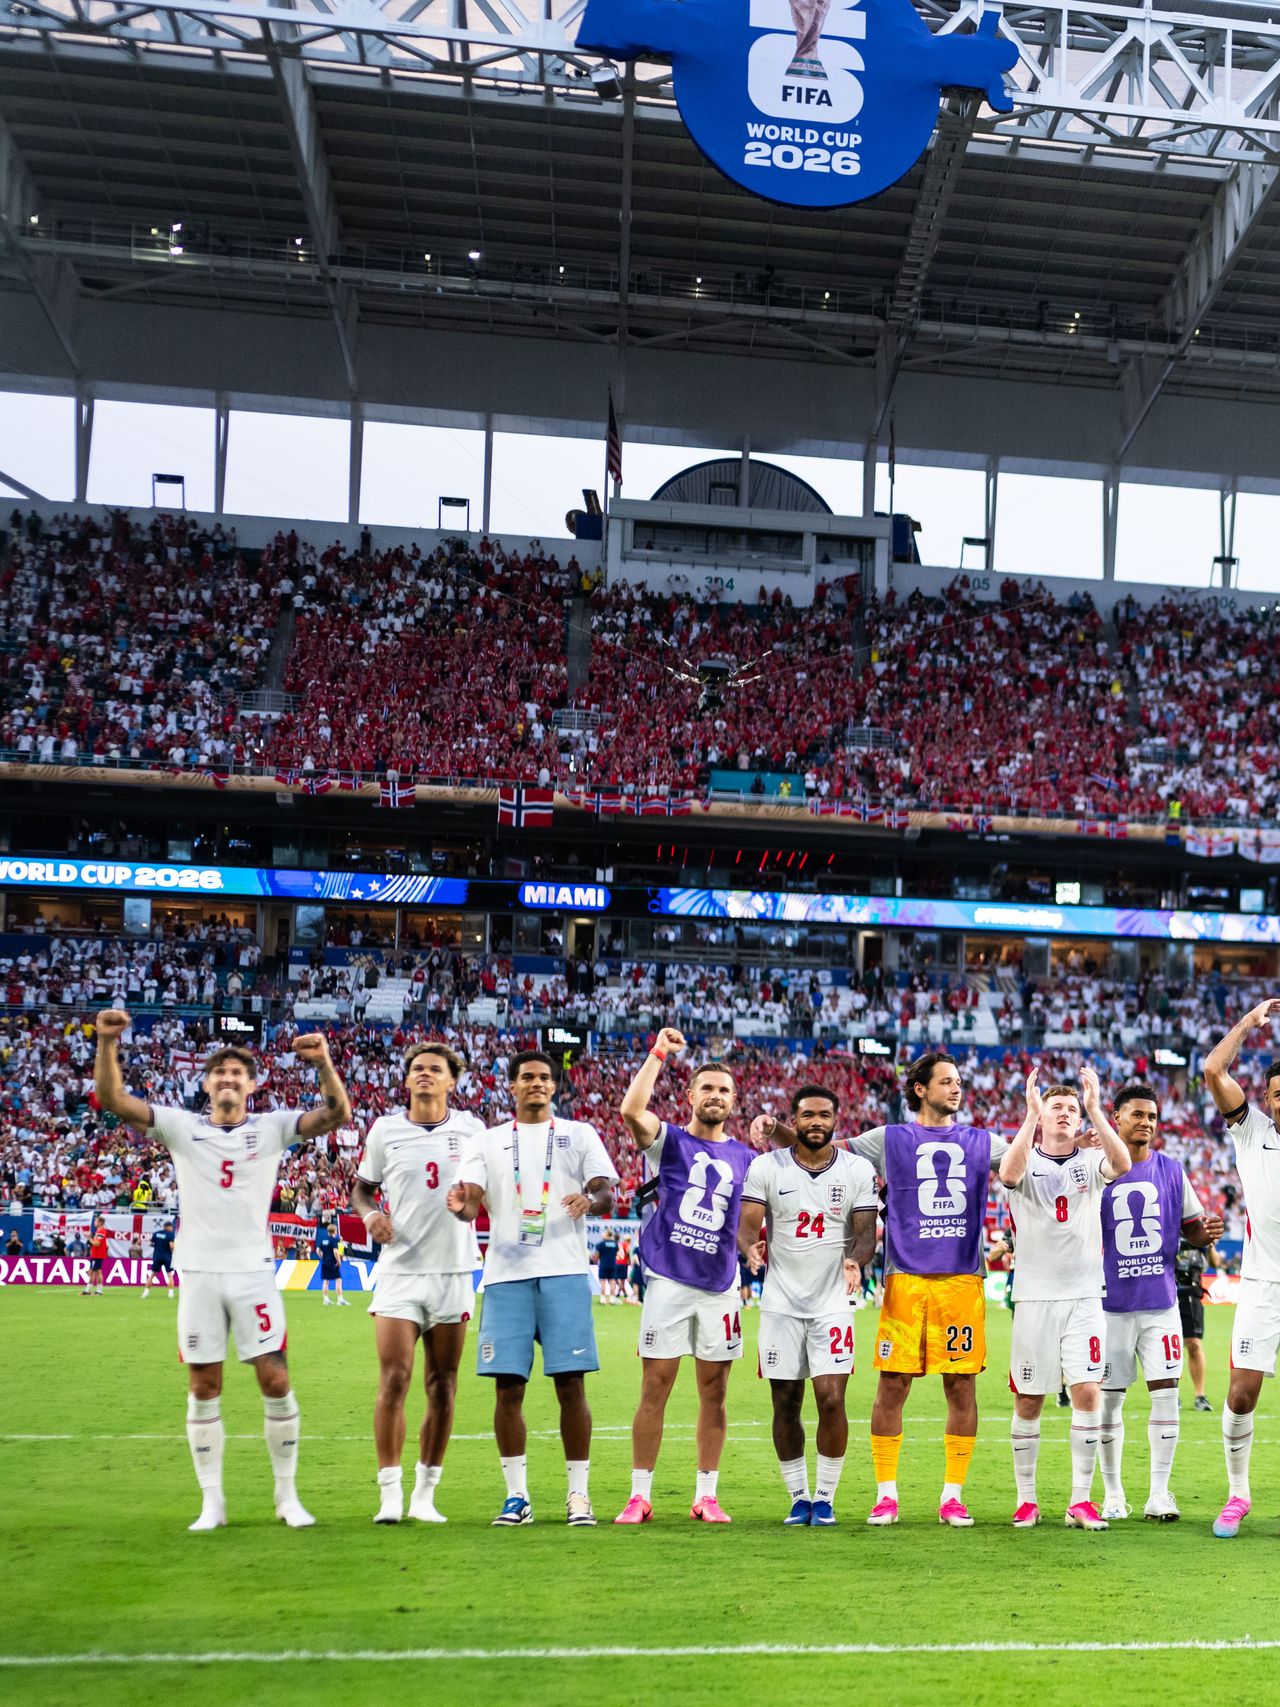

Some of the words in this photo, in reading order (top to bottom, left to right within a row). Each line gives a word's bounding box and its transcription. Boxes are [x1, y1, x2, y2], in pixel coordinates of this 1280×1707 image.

[781, 85, 833, 107] FIFA
[746, 122, 819, 144] WORLD
[822, 131, 862, 148] CUP
[744, 141, 861, 176] 2026
[81, 865, 132, 885] CUP
[135, 868, 222, 889] 2026
[524, 885, 605, 907] MIAMI
[220, 1160, 235, 1189] 5
[426, 1161, 439, 1190] 3
[692, 1209, 713, 1223] FIFA
[932, 1200, 955, 1209] FIFA
[1055, 1195, 1068, 1223] 8
[673, 1222, 704, 1238] WORLD
[704, 1232, 720, 1242] CUP
[796, 1211, 825, 1239] 24
[919, 1219, 950, 1227] WORLD
[919, 1226, 967, 1239] 2026
[669, 1231, 718, 1255] 2026
[1129, 1239, 1150, 1249] FIFA
[1117, 1257, 1146, 1266] WORLD
[1147, 1256, 1163, 1264] CUP
[1118, 1264, 1165, 1278] 2026
[254, 1302, 272, 1333] 5
[722, 1311, 742, 1341] 14
[829, 1325, 854, 1355] 24
[945, 1324, 973, 1352] 23
[1088, 1335, 1101, 1364] 8
[1161, 1333, 1181, 1361] 19
